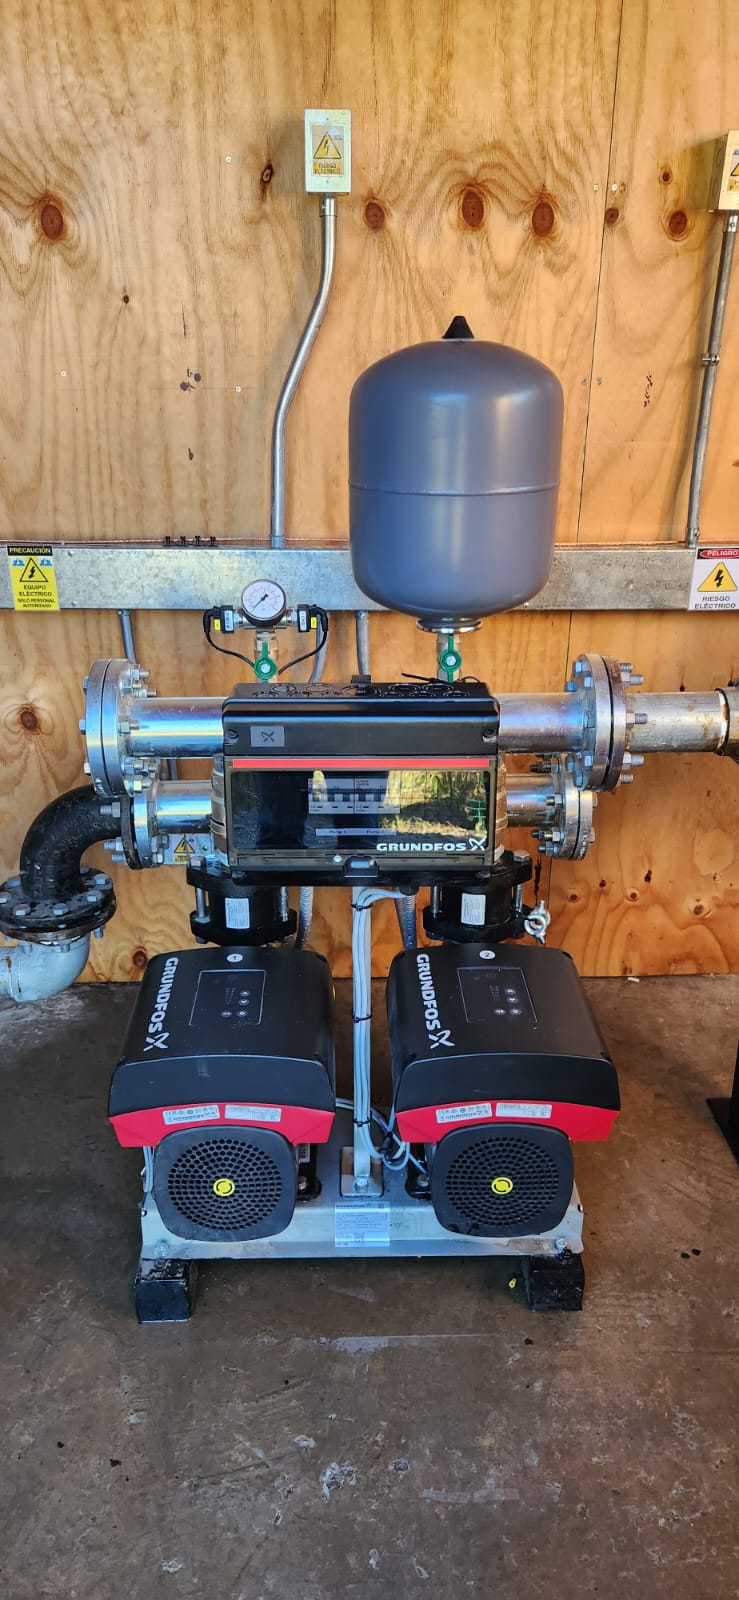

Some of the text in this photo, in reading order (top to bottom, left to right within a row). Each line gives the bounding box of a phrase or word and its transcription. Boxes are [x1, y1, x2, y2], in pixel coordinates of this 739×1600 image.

[376, 842, 467, 851] GRUNDFOS
[147, 957, 179, 1034] GRUNDFOS
[416, 953, 441, 1031] GRUNDFOS
